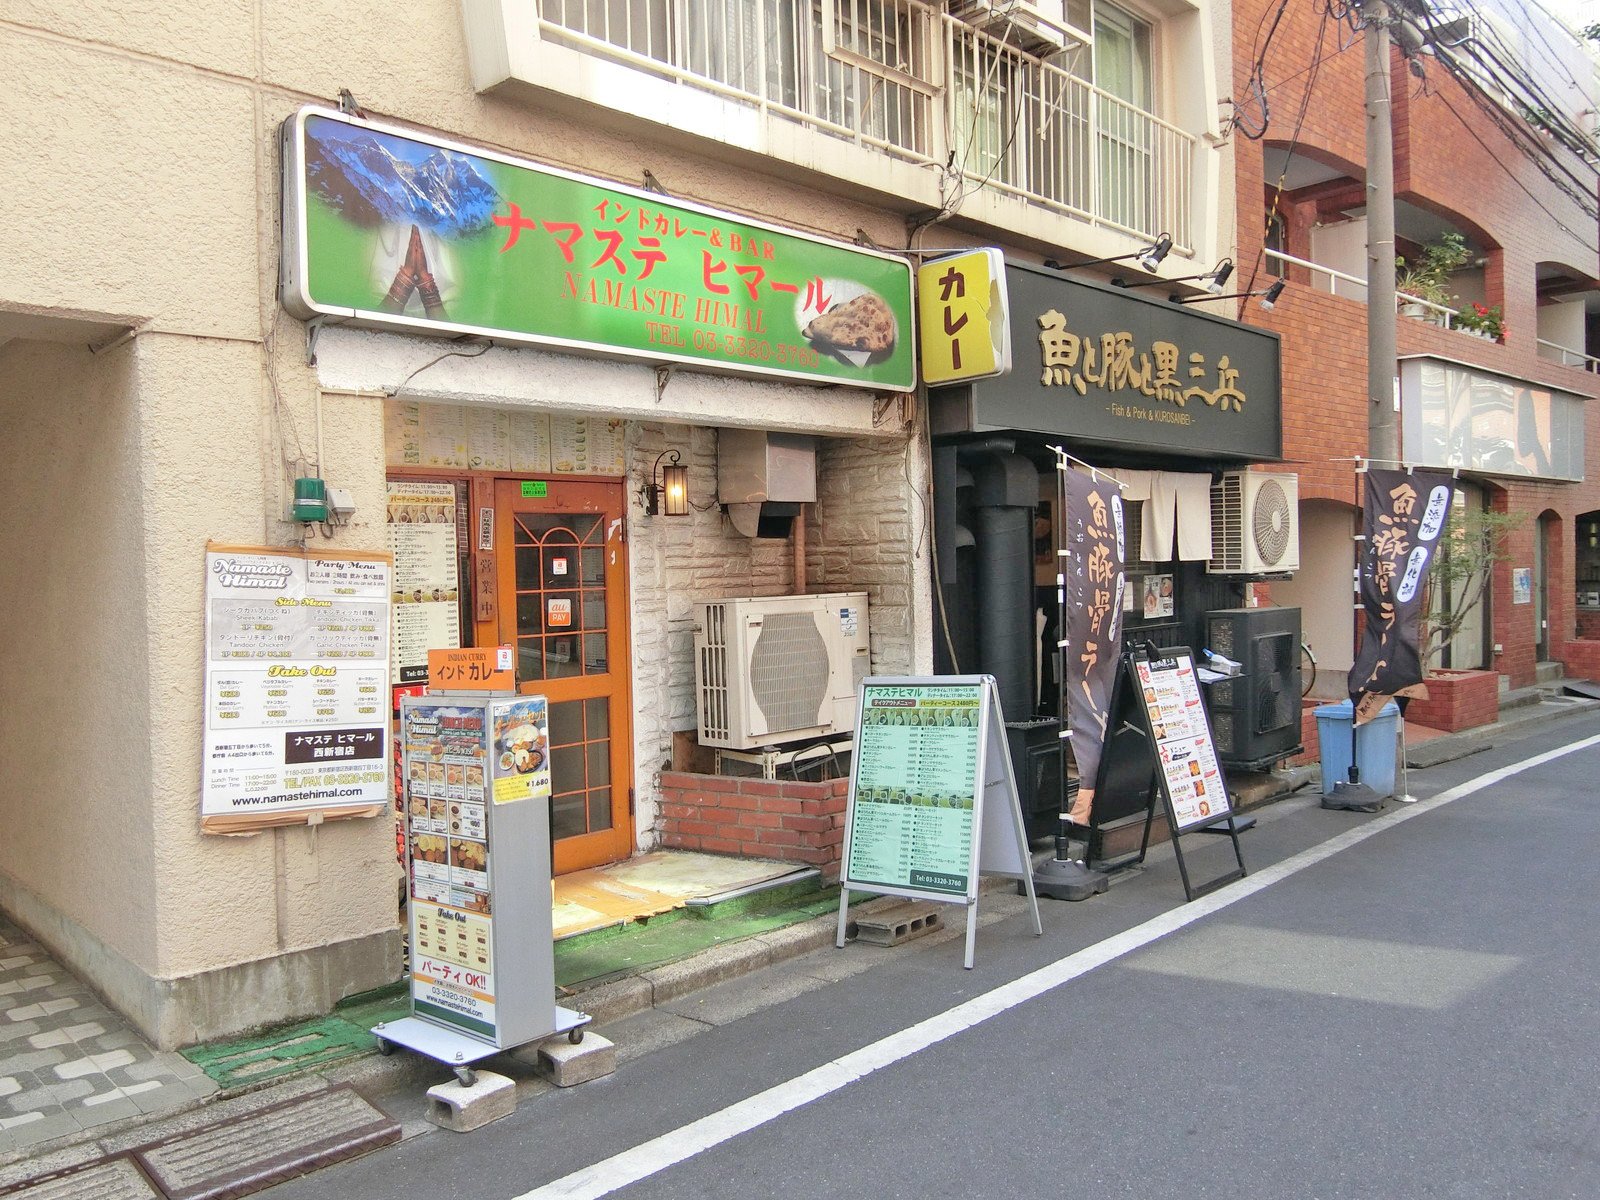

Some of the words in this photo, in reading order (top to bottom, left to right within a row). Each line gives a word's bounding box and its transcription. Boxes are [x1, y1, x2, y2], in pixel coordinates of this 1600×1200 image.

[491, 200, 667, 281] ナマステ
[701, 248, 832, 315] ヒマール
[561, 271, 687, 320] NAMASTE
[695, 297, 767, 334] HIMAL
[938, 266, 968, 370] カレー
[646, 321, 685, 347] TEL
[693, 329, 820, 368] 03-3320-3760
[1111, 402, 1125, 416] Fish
[1126, 406, 1131, 418] &
[1132, 406, 1147, 419] Pork
[1148, 410, 1153, 421] &
[1154, 409, 1191, 426] KUROSANBEI
[213, 558, 293, 576] Namaste
[314, 559, 345, 571] Party
[347, 561, 376, 570] Menu
[218, 573, 288, 590] Himal
[480, 559, 493, 616] 営業中
[274, 597, 300, 607] Side
[300, 597, 333, 607] Menu
[551, 604, 568, 612] au
[552, 613, 567, 622] PAY
[447, 653, 468, 662] INDIAN
[468, 652, 487, 661] CURRY
[268, 665, 308, 677] Take
[309, 665, 337, 677] Out
[868, 687, 923, 698] ナマステヒマル
[408, 713, 441, 726] Namaste
[410, 724, 439, 735] Himal
[294, 735, 333, 746] ナマステ
[337, 733, 376, 744] ヒマール
[313, 746, 355, 758] 西新宿店
[283, 775, 322, 789] TEL/FAX
[323, 772, 385, 786] 03-3320-3760
[232, 788, 363, 806] www.namastehimal.com
[915, 874, 925, 882] Tel:
[925, 876, 962, 887] 03-3320-3760
[422, 960, 462, 984] パーティ
[465, 972, 486, 992] OK!!
[431, 986, 477, 1007] 03-3320-3760
[426, 994, 484, 1018] www.namastehimal.com
